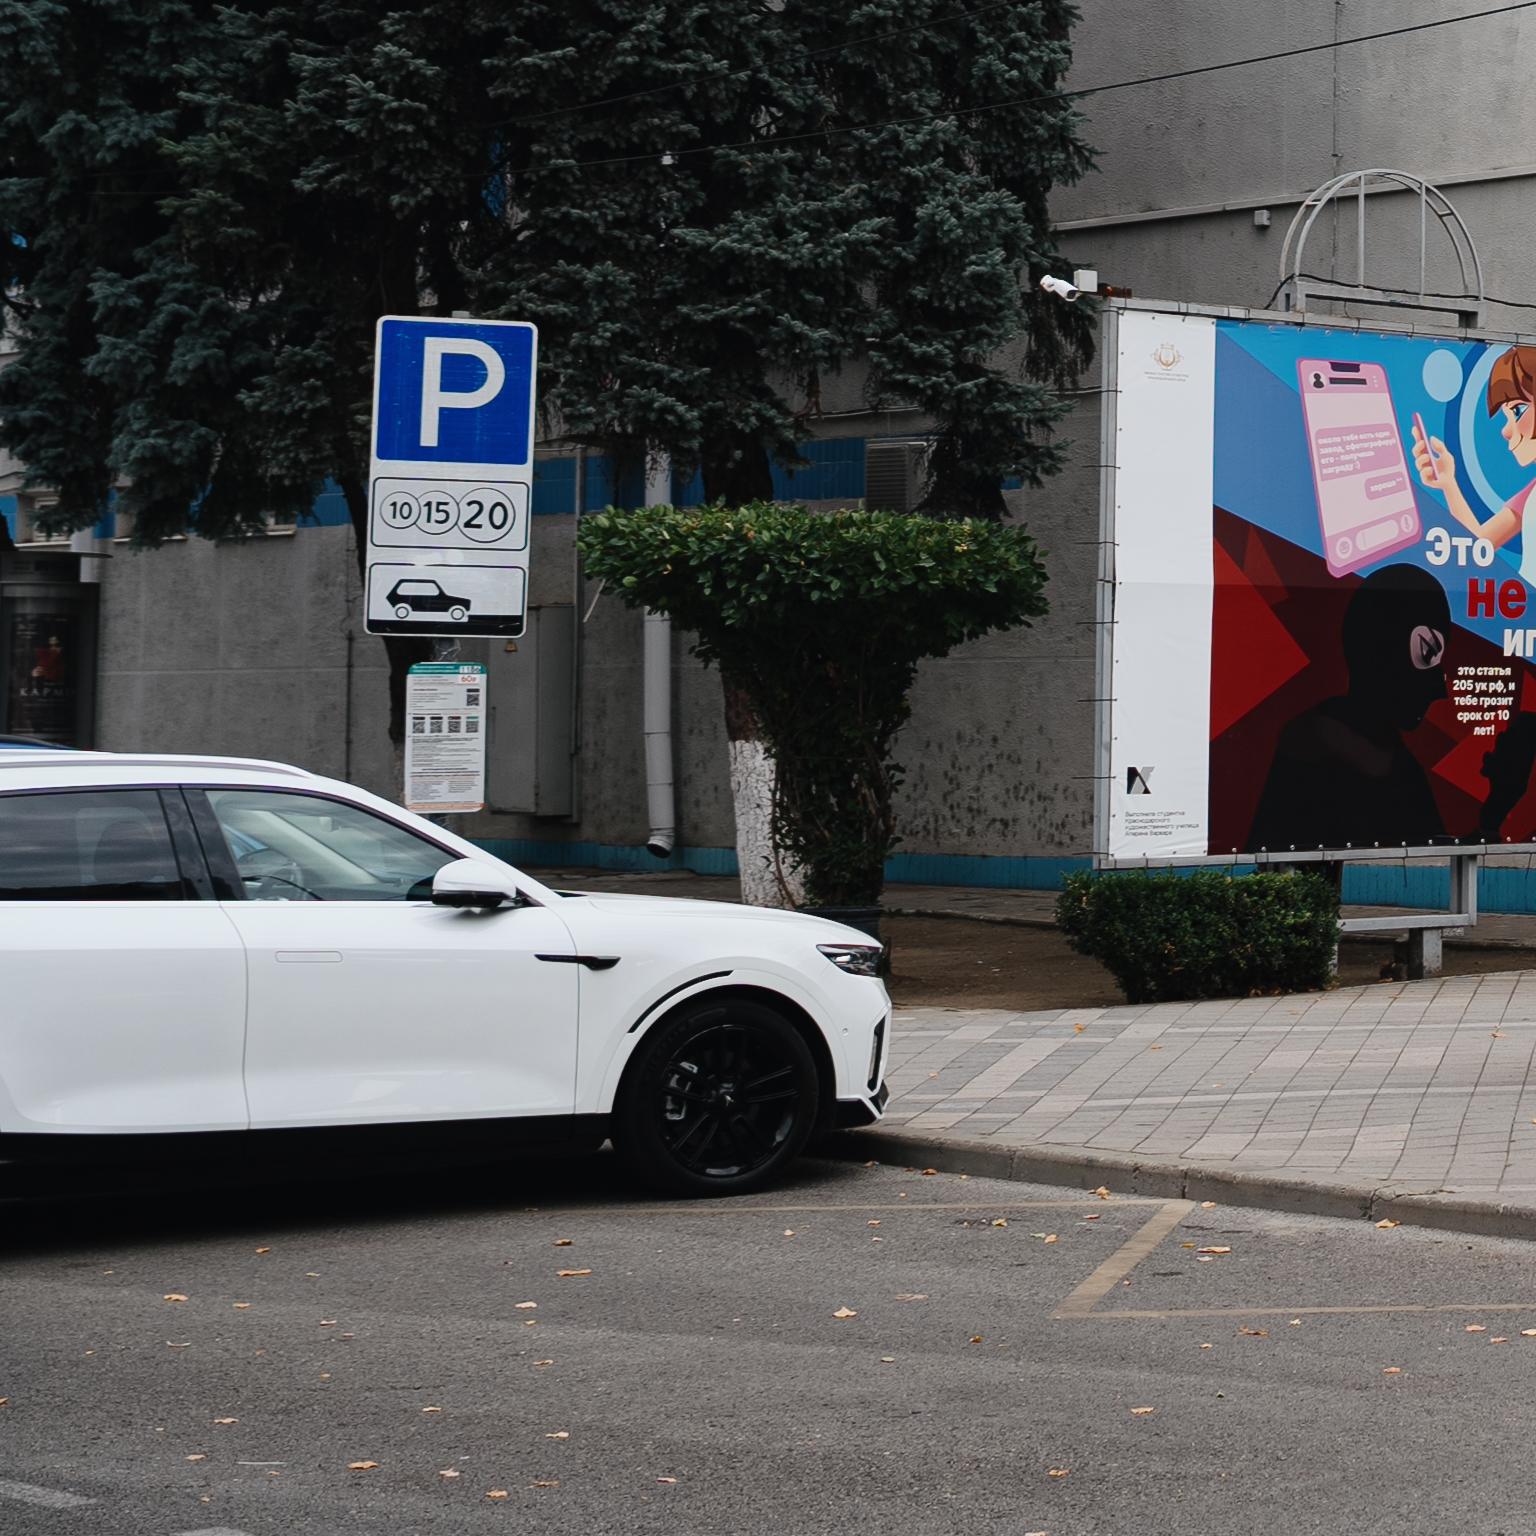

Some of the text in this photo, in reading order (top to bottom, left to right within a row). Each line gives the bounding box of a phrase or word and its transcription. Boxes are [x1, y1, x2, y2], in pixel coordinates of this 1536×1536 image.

[389, 500, 508, 530] 10 15 20
[1425, 526, 1495, 567] Это
[1466, 577, 1528, 620] не
[1457, 667, 1512, 676] это статья
[1452, 679, 1516, 693] 205 ук рф, и
[1454, 695, 1514, 707] тебе грозит
[1456, 710, 1510, 723] срок от 10
[1473, 725, 1495, 736] лет!
